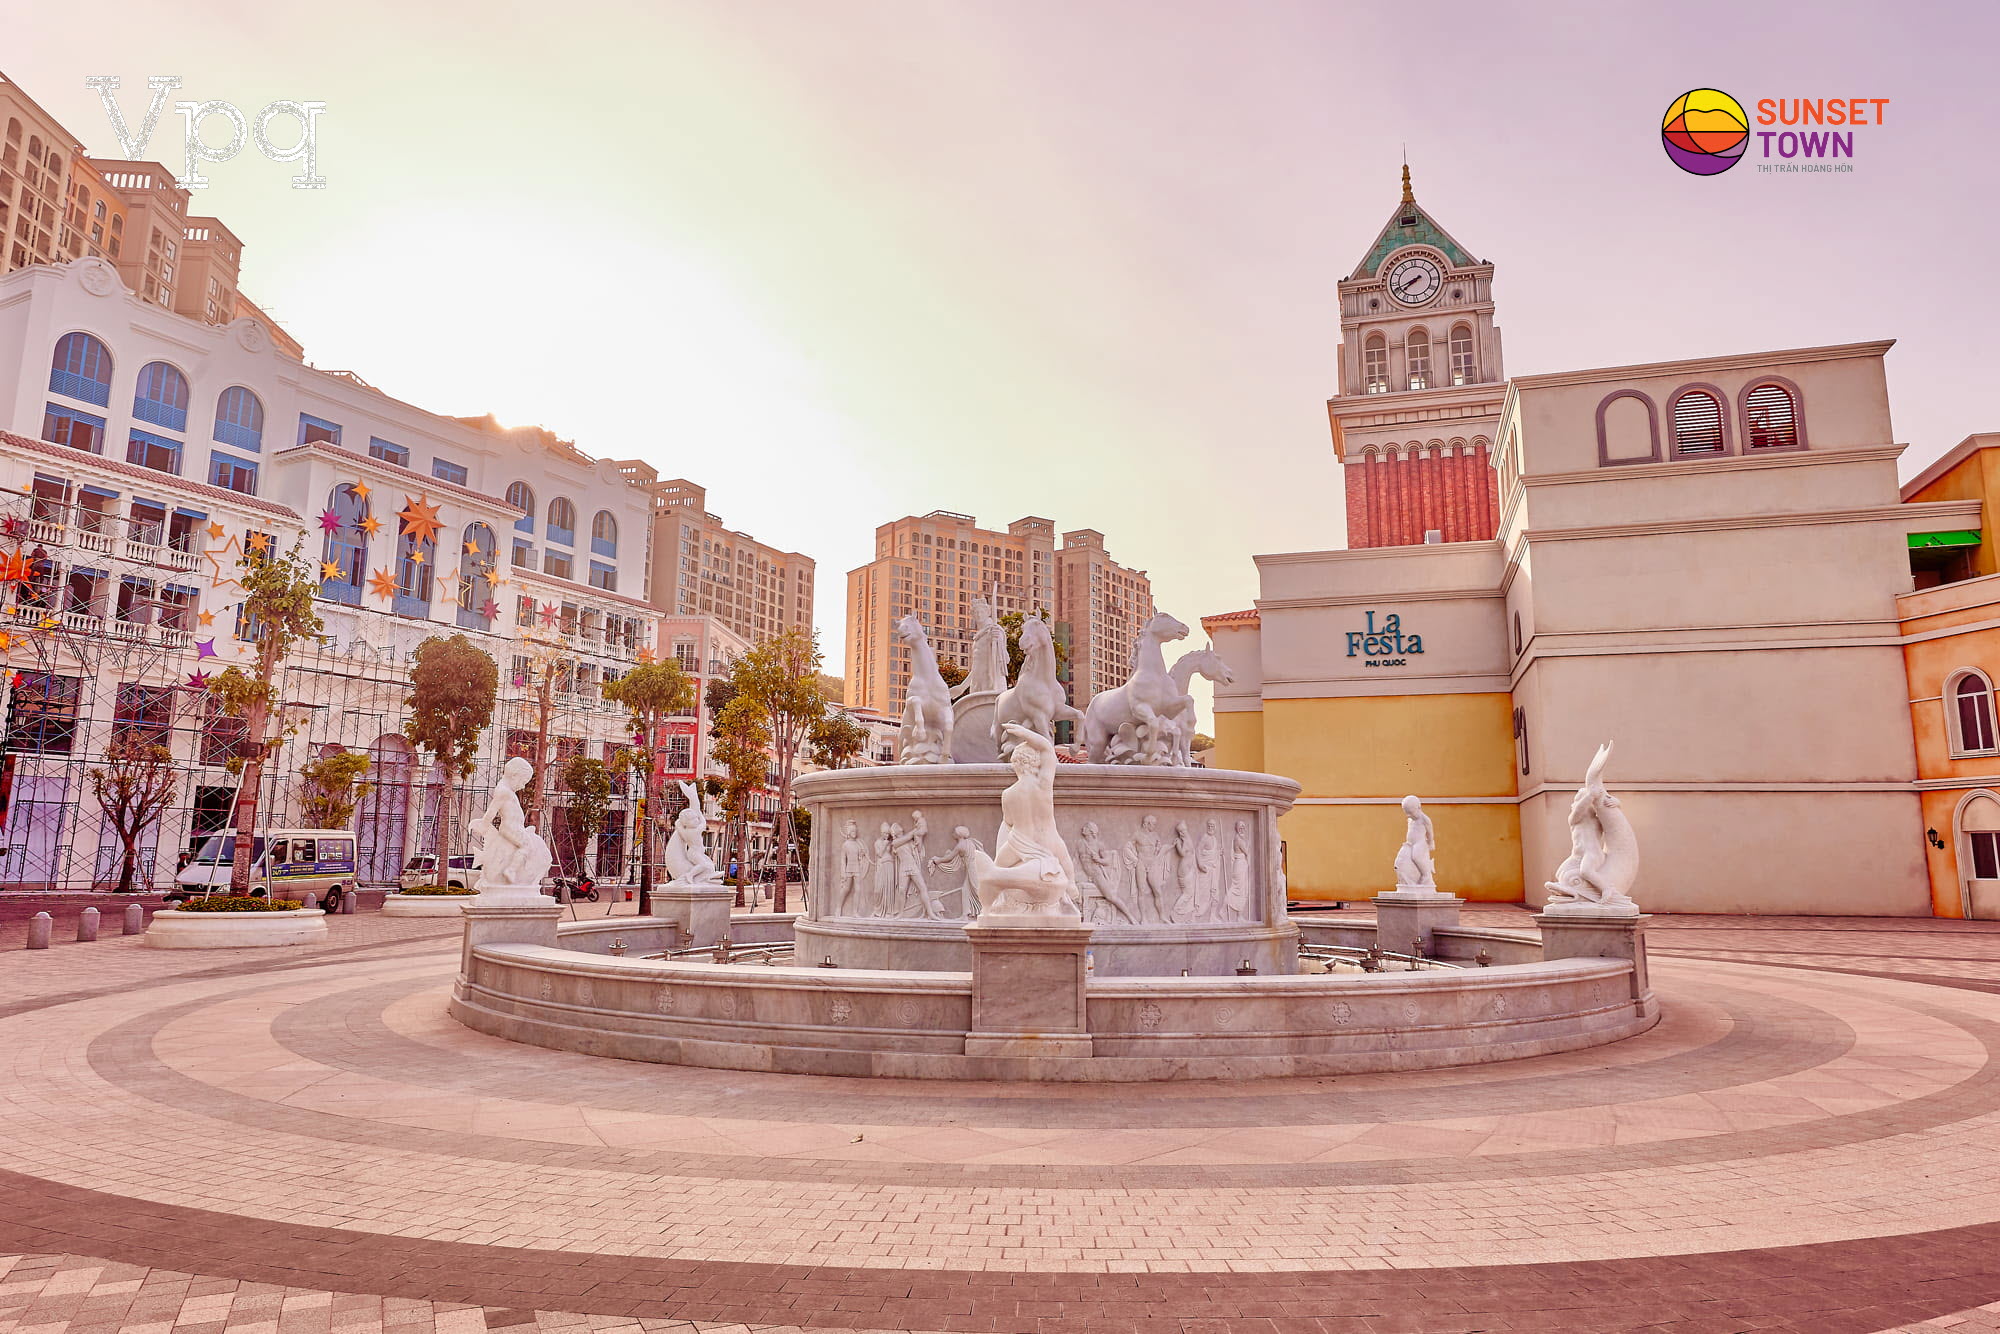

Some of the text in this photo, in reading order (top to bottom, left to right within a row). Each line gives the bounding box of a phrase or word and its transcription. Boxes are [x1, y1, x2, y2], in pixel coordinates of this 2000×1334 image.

[1365, 611, 1401, 635] La
[1345, 629, 1424, 657] Festa
[1365, 659, 1407, 668] PHU QUOC
